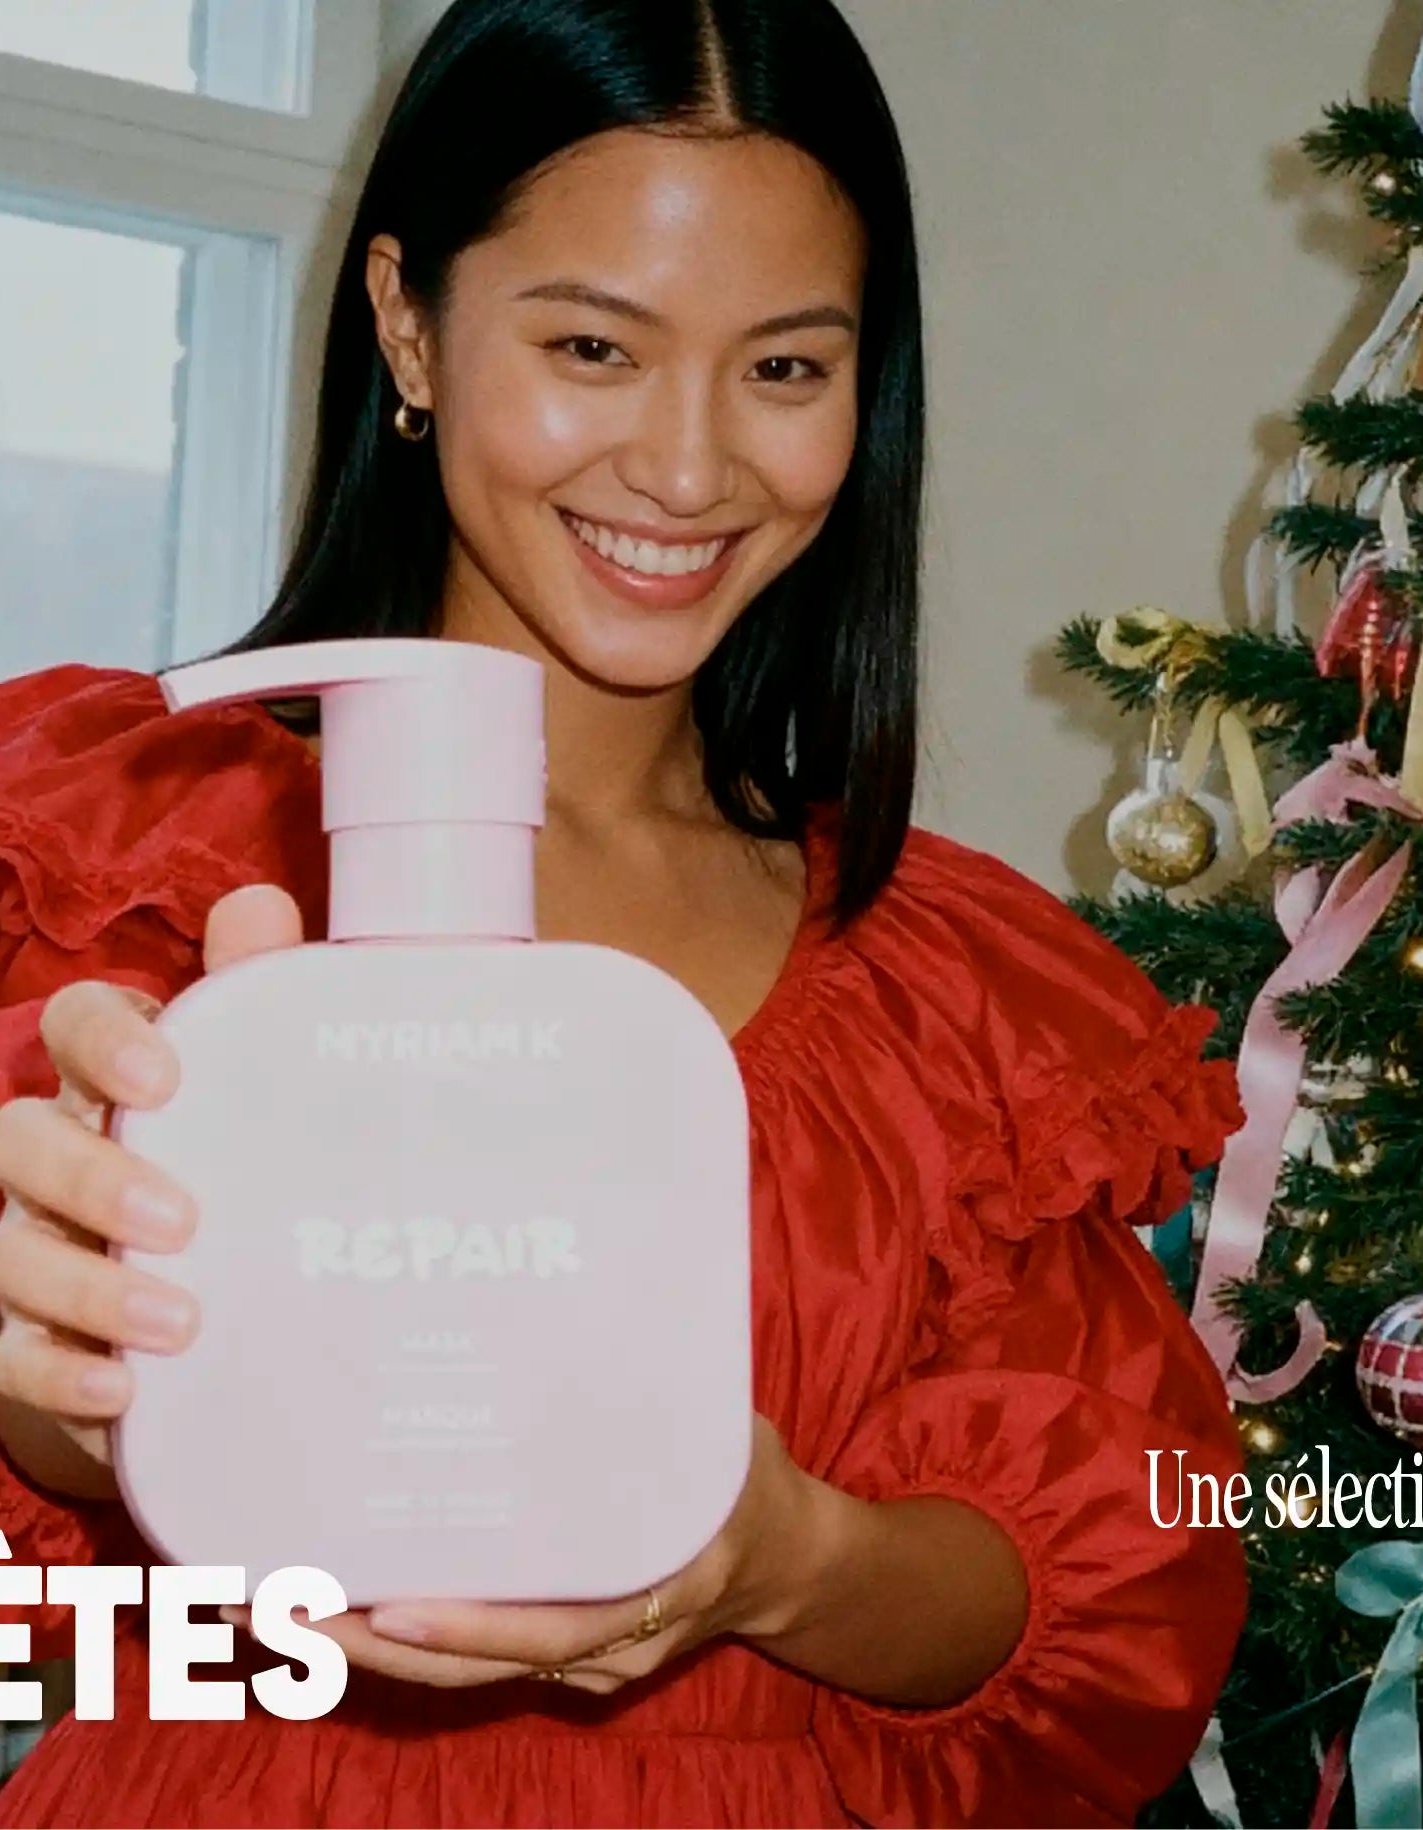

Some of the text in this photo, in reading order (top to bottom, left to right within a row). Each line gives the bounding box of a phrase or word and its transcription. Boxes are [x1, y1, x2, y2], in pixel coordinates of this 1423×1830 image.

[316, 1018, 565, 1062] MYRIAM K
[293, 1217, 581, 1282] REPAIR
